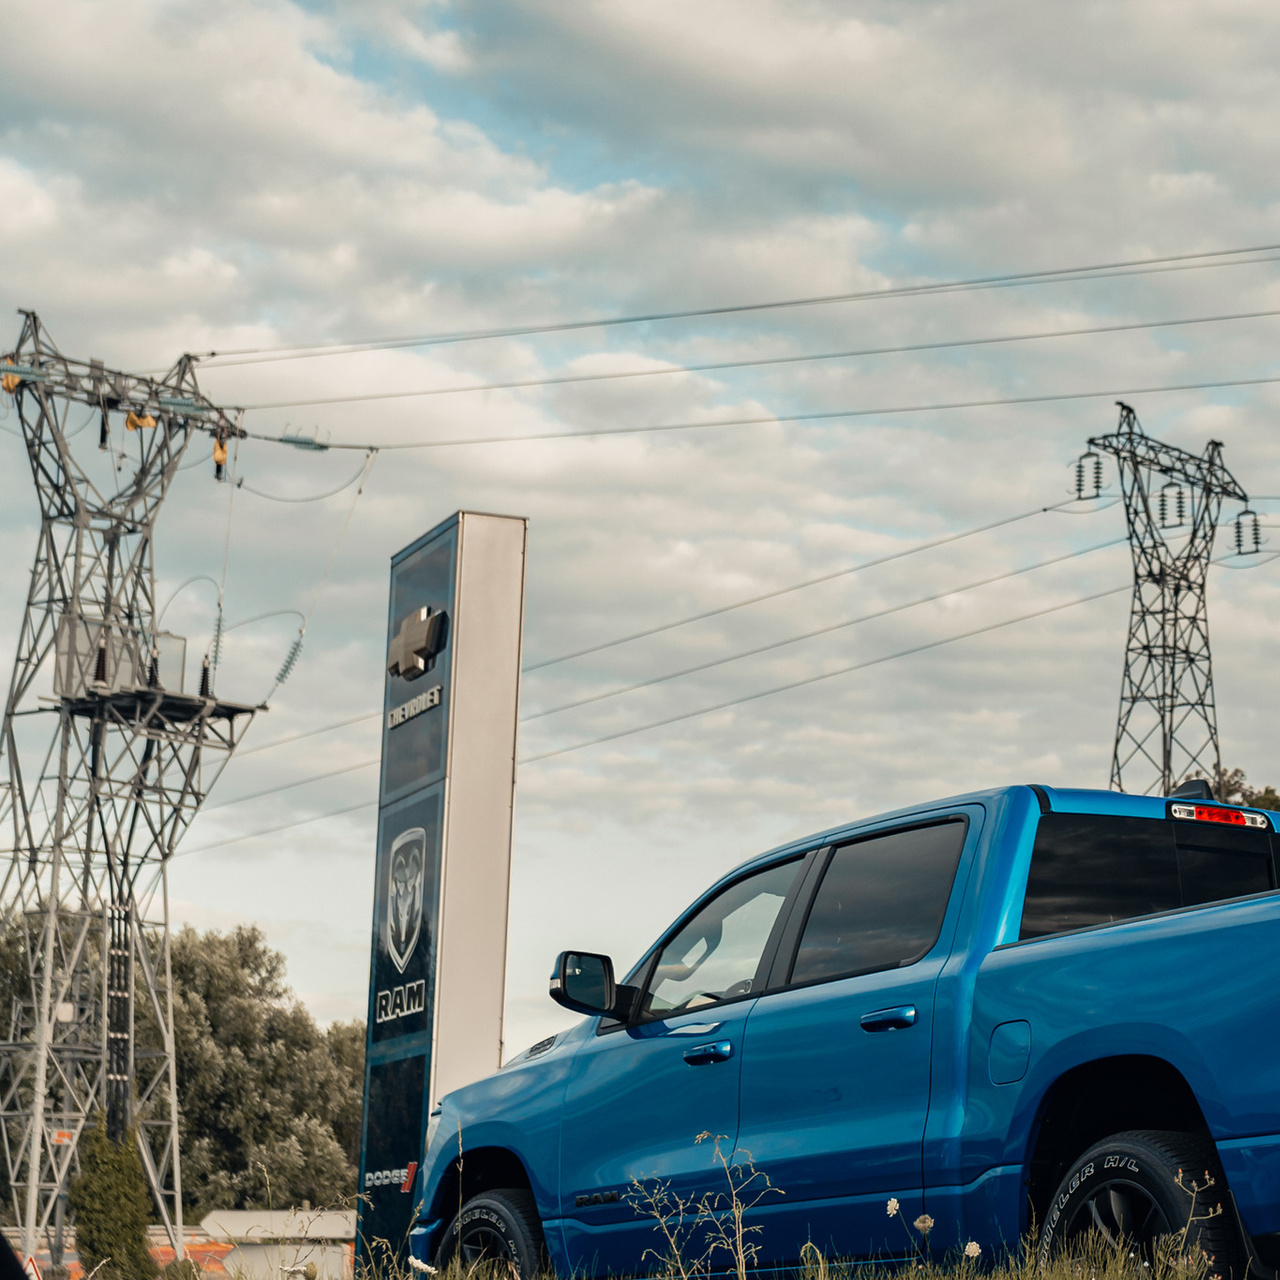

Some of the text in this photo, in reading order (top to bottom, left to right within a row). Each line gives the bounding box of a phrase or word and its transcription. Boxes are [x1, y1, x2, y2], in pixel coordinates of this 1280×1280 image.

[388, 685, 441, 728] CHEVROLET
[376, 979, 425, 1023] RAM
[1104, 1155, 1139, 1173] H/L
[365, 1169, 409, 1187] DODGE
[576, 1190, 619, 1208] RAM
